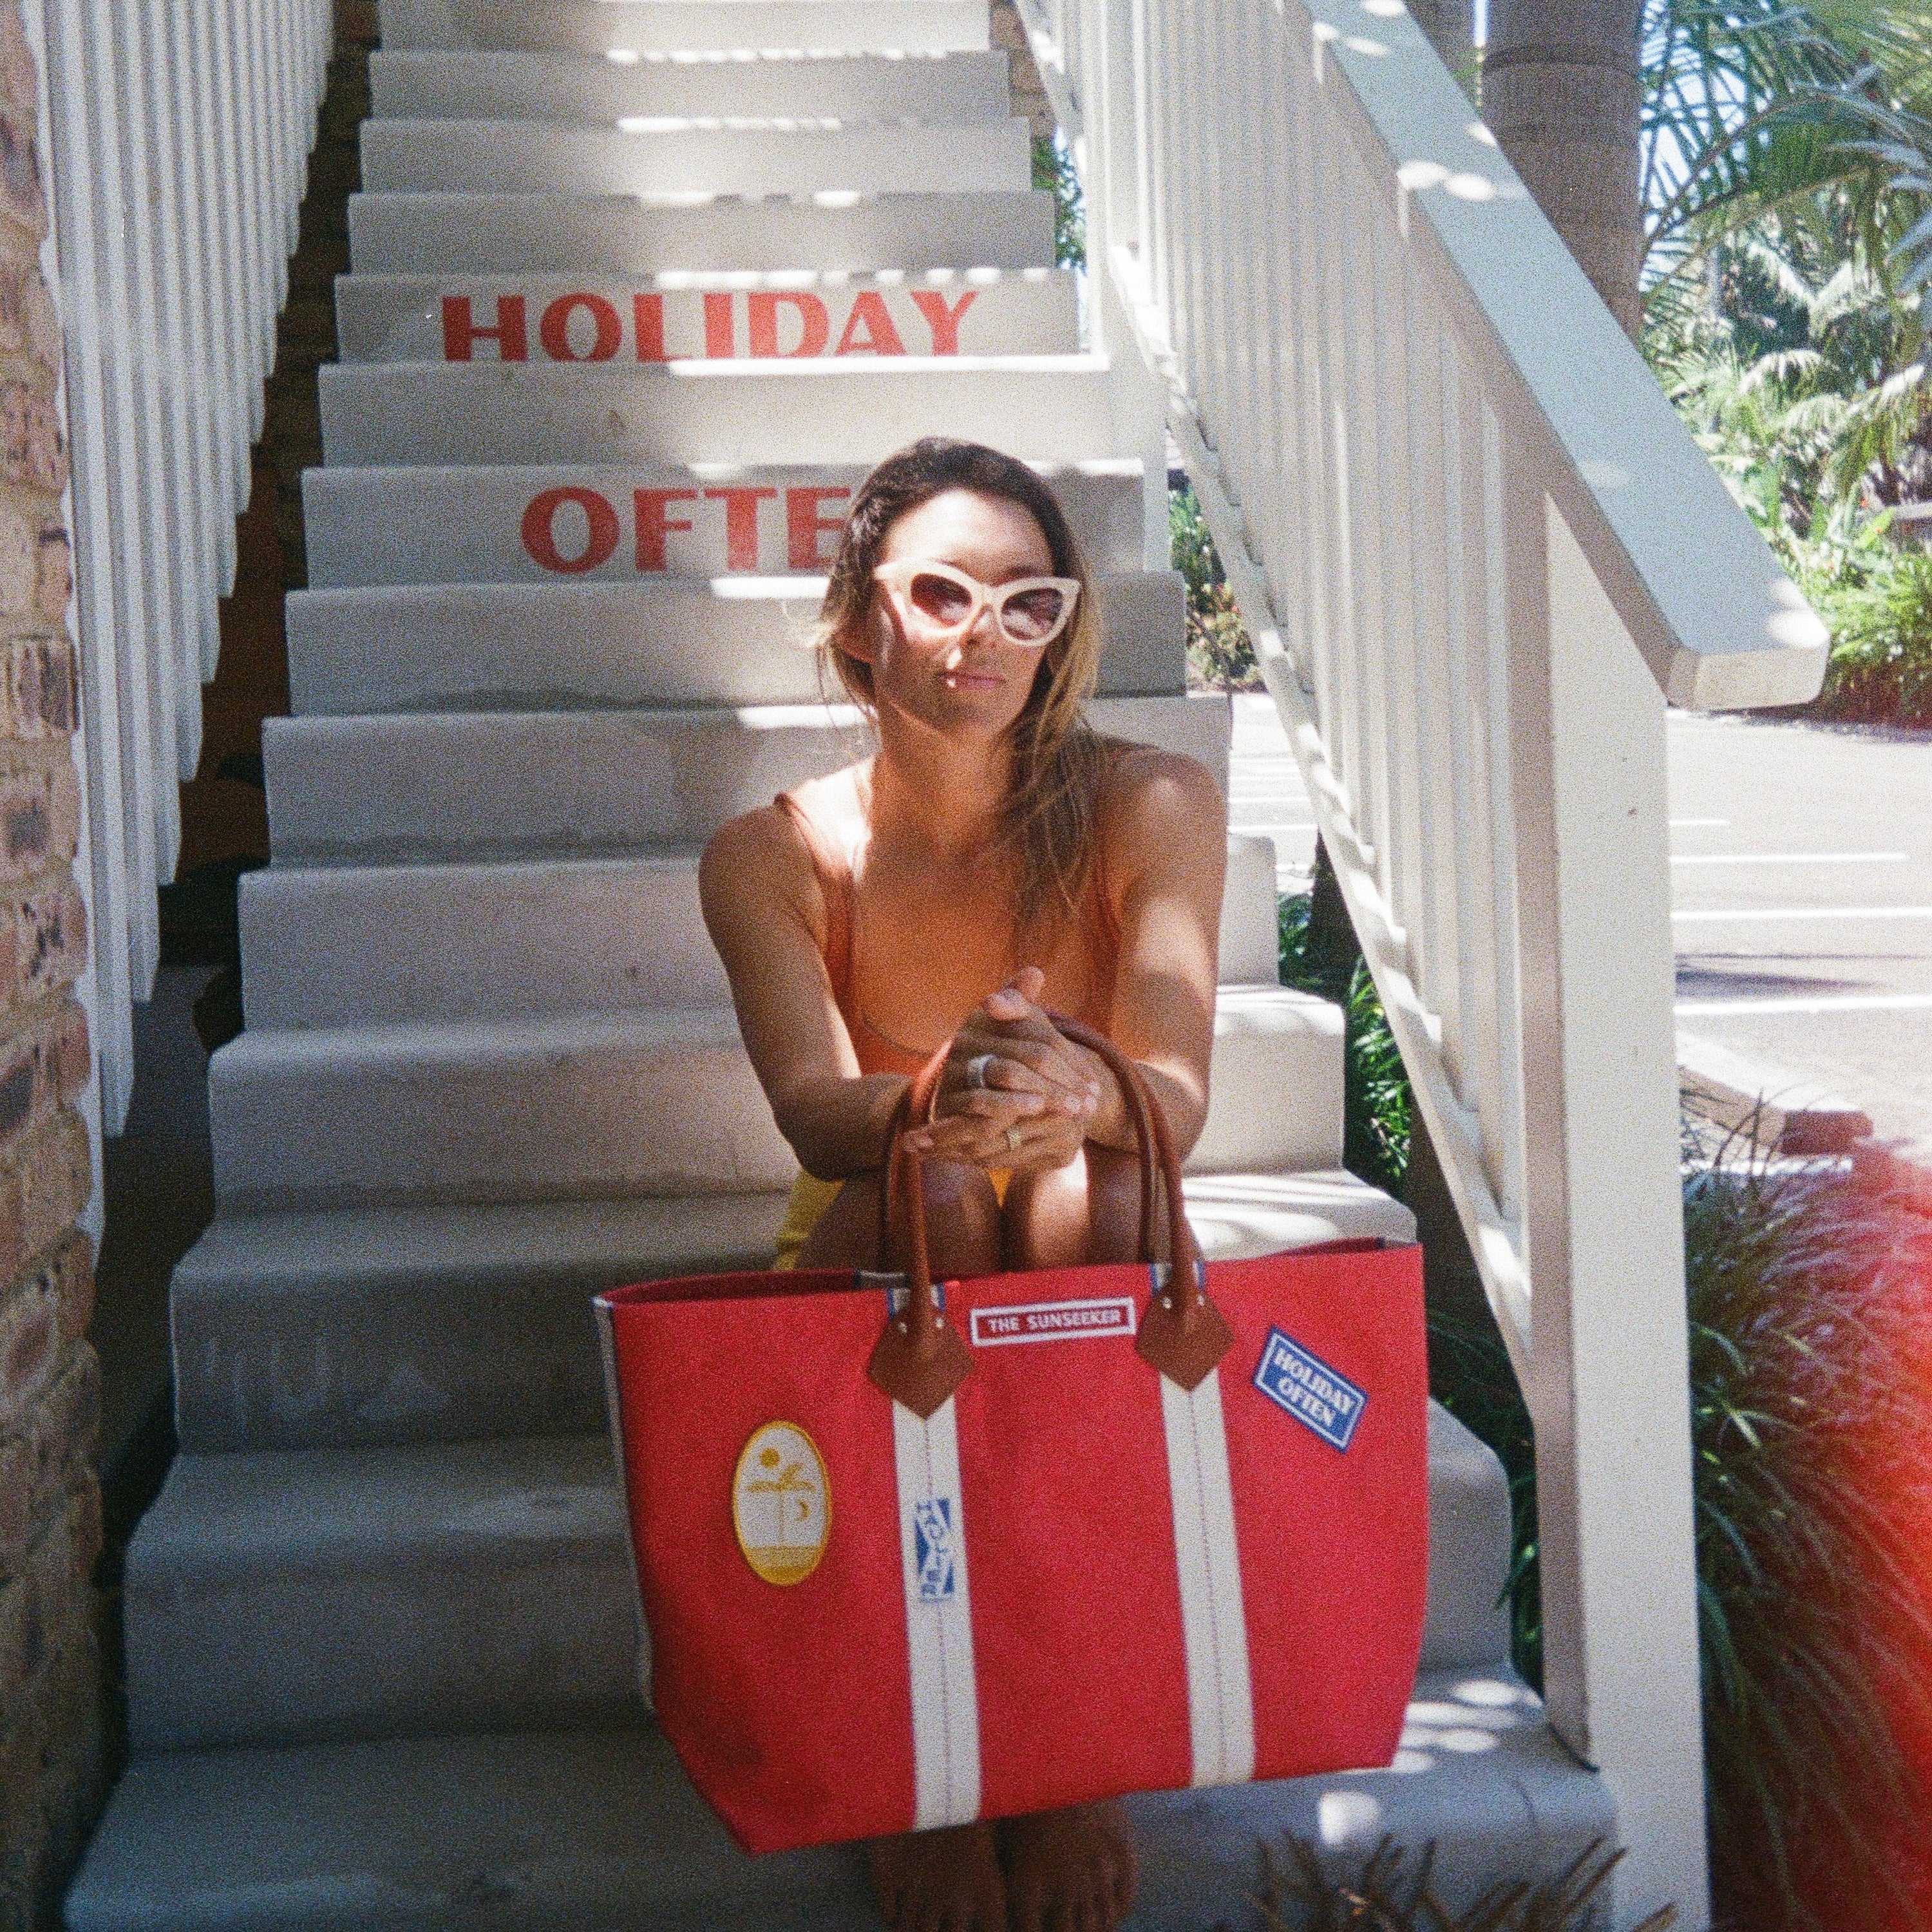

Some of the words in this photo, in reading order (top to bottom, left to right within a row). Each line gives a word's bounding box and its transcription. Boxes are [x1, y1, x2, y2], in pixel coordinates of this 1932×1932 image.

[442, 291, 978, 362] HOLIDAY
[521, 486, 851, 573] OFTE
[988, 1317, 1020, 1332] THE
[1027, 1310, 1121, 1329] SUNSEEKER
[1275, 1349, 1354, 1414] HOLIDAY
[1279, 1378, 1337, 1426] OFTEN
